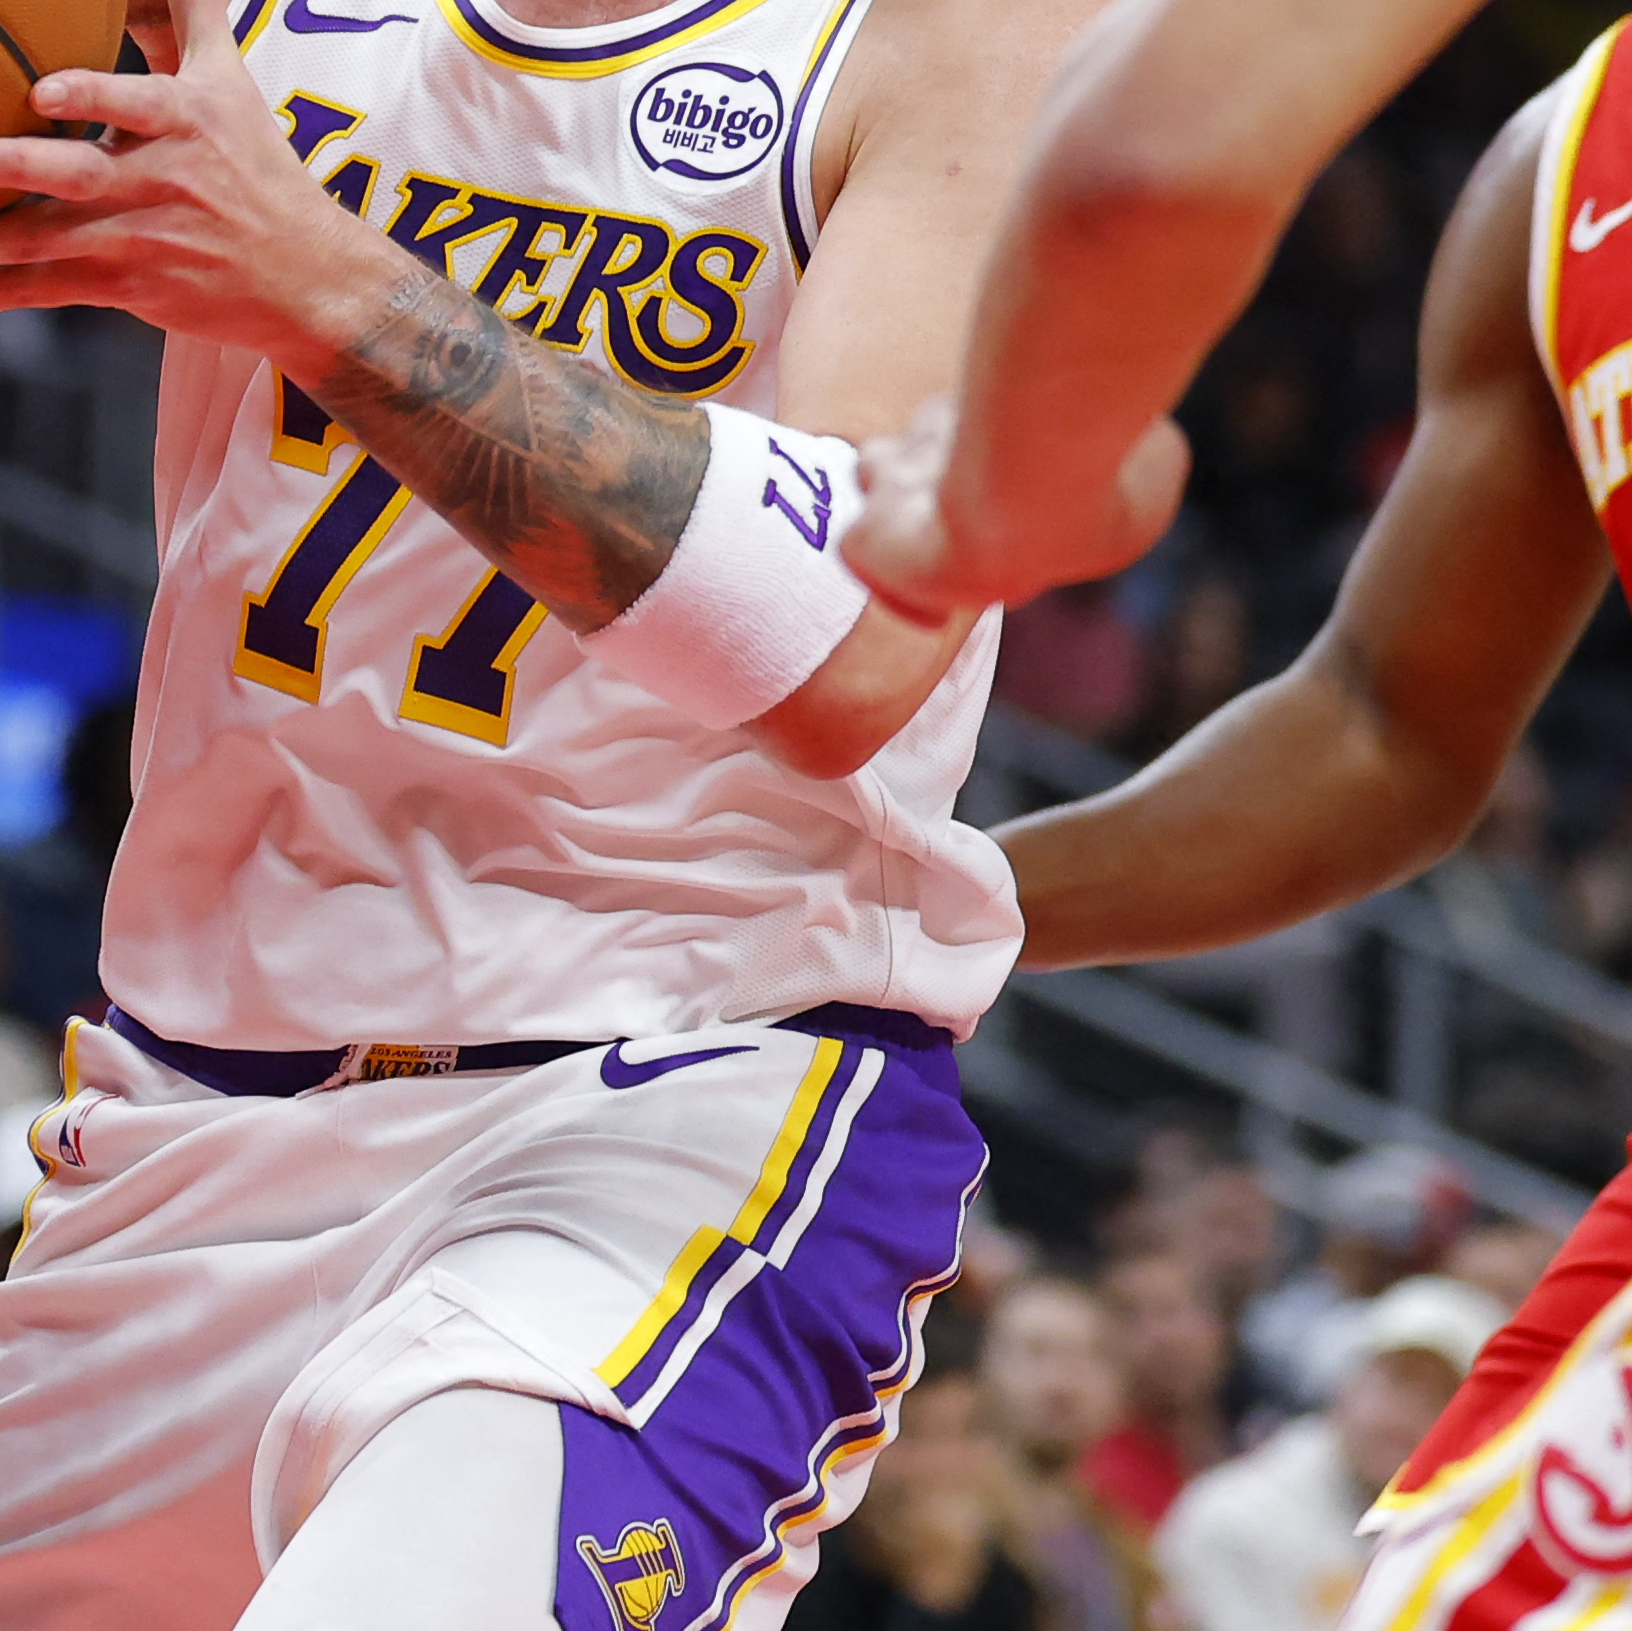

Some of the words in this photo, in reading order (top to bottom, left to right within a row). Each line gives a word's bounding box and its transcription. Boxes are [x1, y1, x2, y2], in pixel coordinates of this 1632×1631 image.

[646, 86, 774, 150] bibigo
[661, 127, 717, 155] 비비고
[370, 1047, 390, 1057] LOS
[391, 1048, 453, 1059] ANGELES
